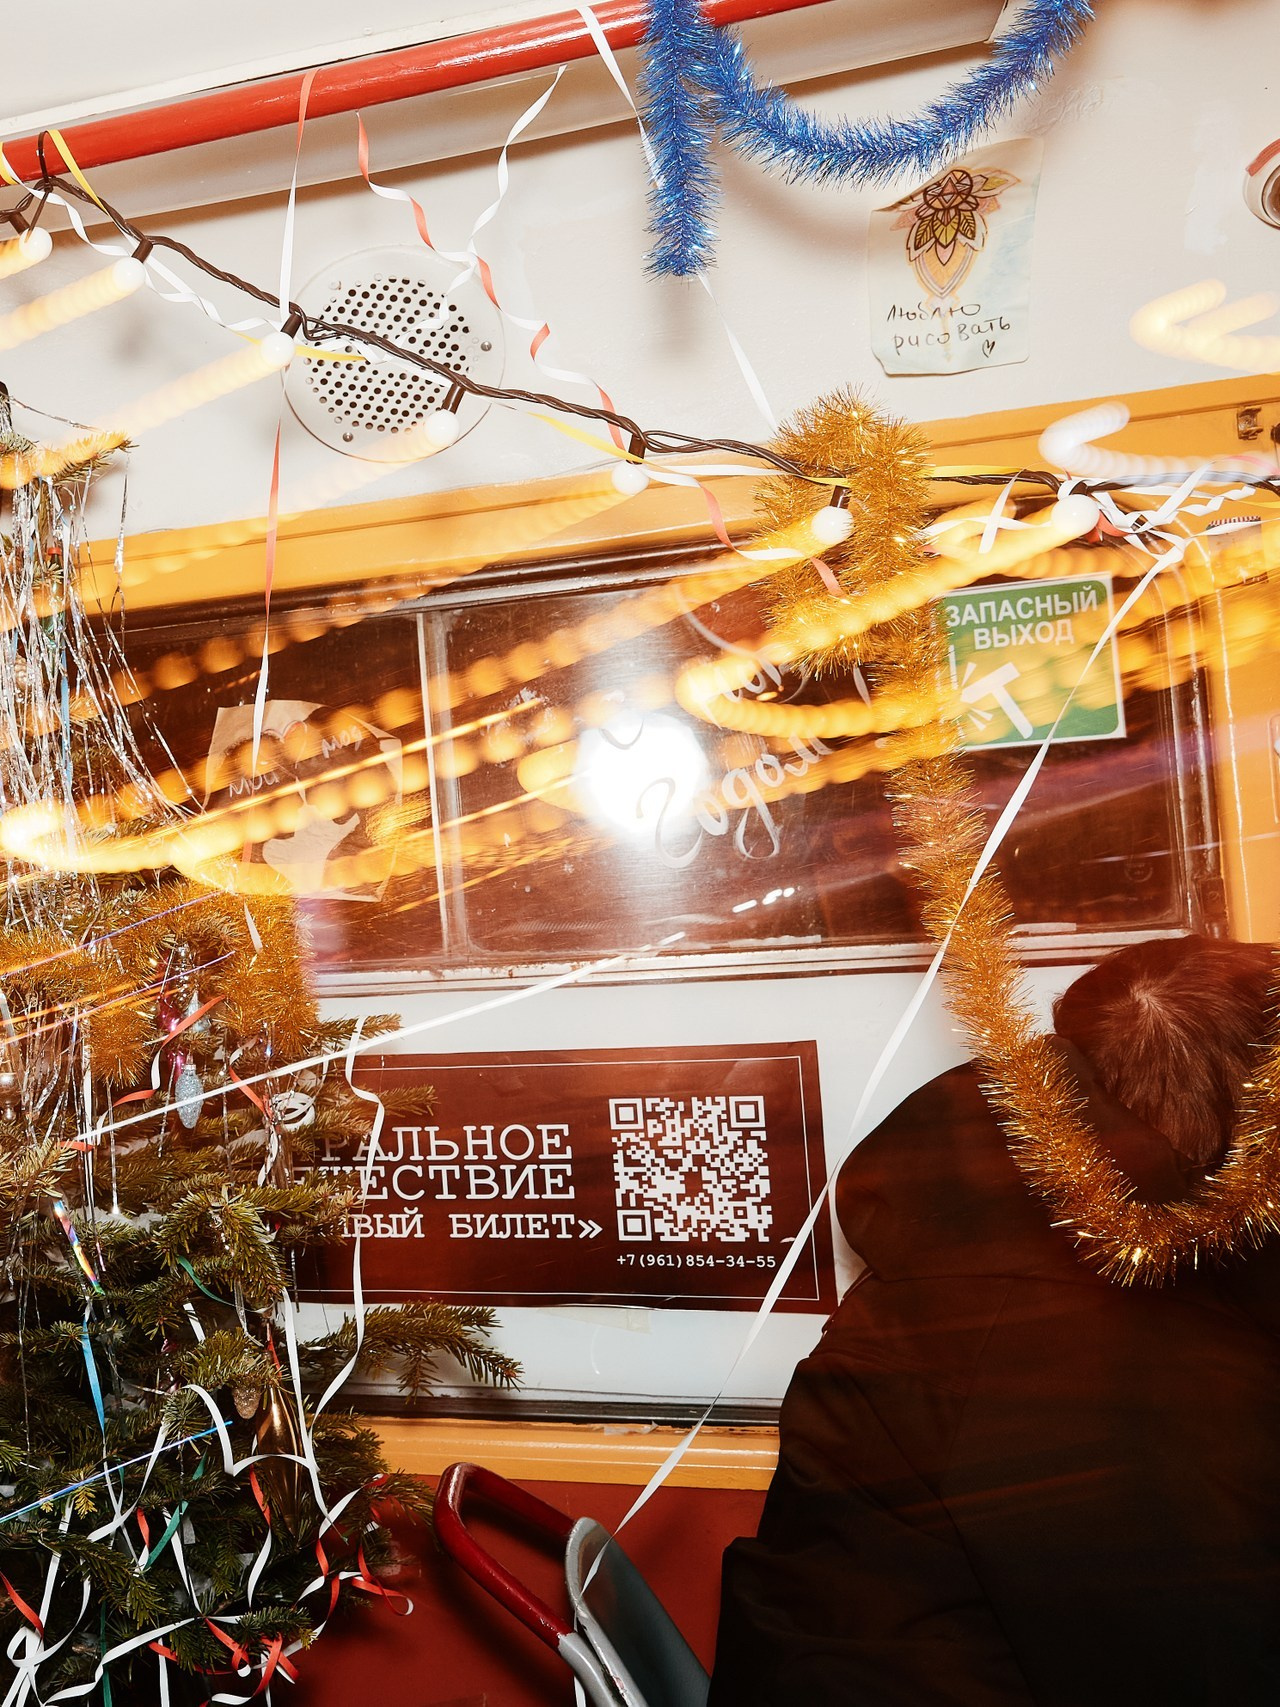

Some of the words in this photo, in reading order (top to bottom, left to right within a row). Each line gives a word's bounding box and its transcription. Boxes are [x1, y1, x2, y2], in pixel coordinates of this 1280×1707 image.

[894, 316, 1011, 356] рисовать
[946, 586, 1098, 627] ЗАПАСНЫЙ
[973, 618, 1075, 650] ВЫХОД
[318, 1124, 573, 1161] РАЛЬНОЕ
[448, 1213, 604, 1240] БИЛЕТ»
[616, 1253, 777, 1269] +7(961)854-34-55
